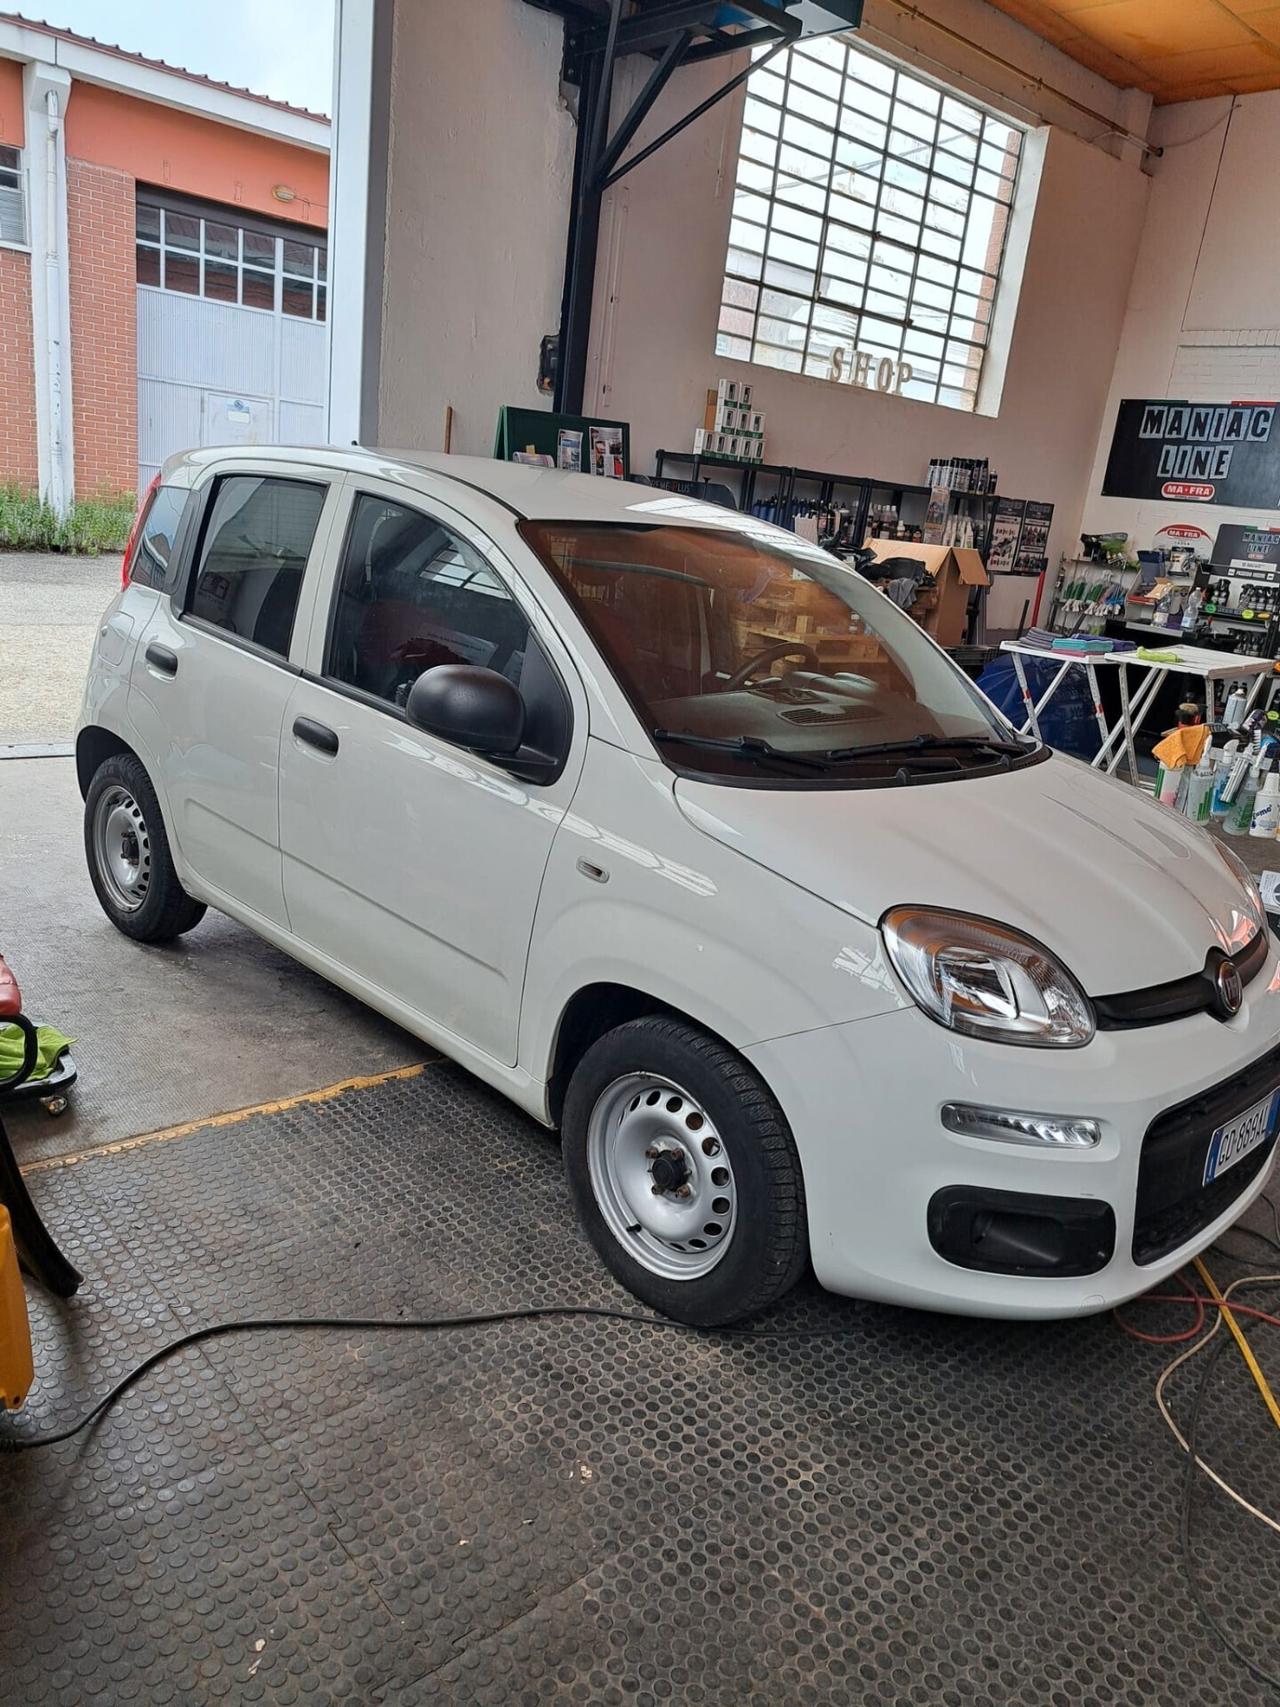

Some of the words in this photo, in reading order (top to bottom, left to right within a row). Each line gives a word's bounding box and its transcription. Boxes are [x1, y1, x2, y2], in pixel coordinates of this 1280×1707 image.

[827, 346, 913, 396] SHOP
[1139, 406, 1275, 441] MANIAC
[1157, 445, 1234, 479] LINE
